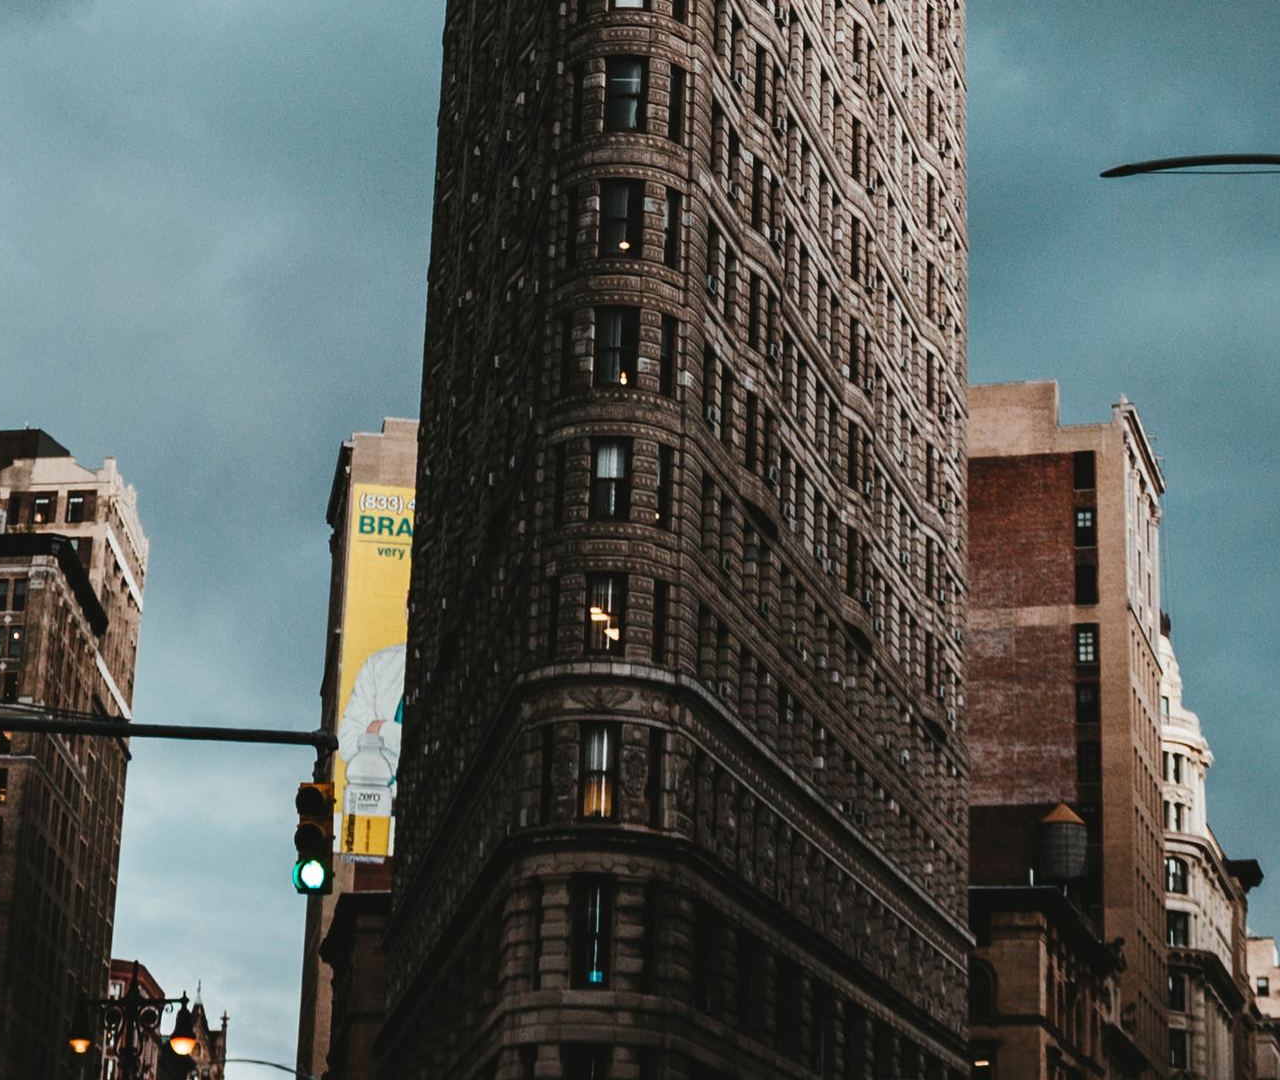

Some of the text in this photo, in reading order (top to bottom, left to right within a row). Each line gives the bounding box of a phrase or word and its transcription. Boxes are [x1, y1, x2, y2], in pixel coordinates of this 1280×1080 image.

[359, 514, 414, 537] BRA
[377, 547, 405, 560] very
[358, 792, 381, 802] zero
